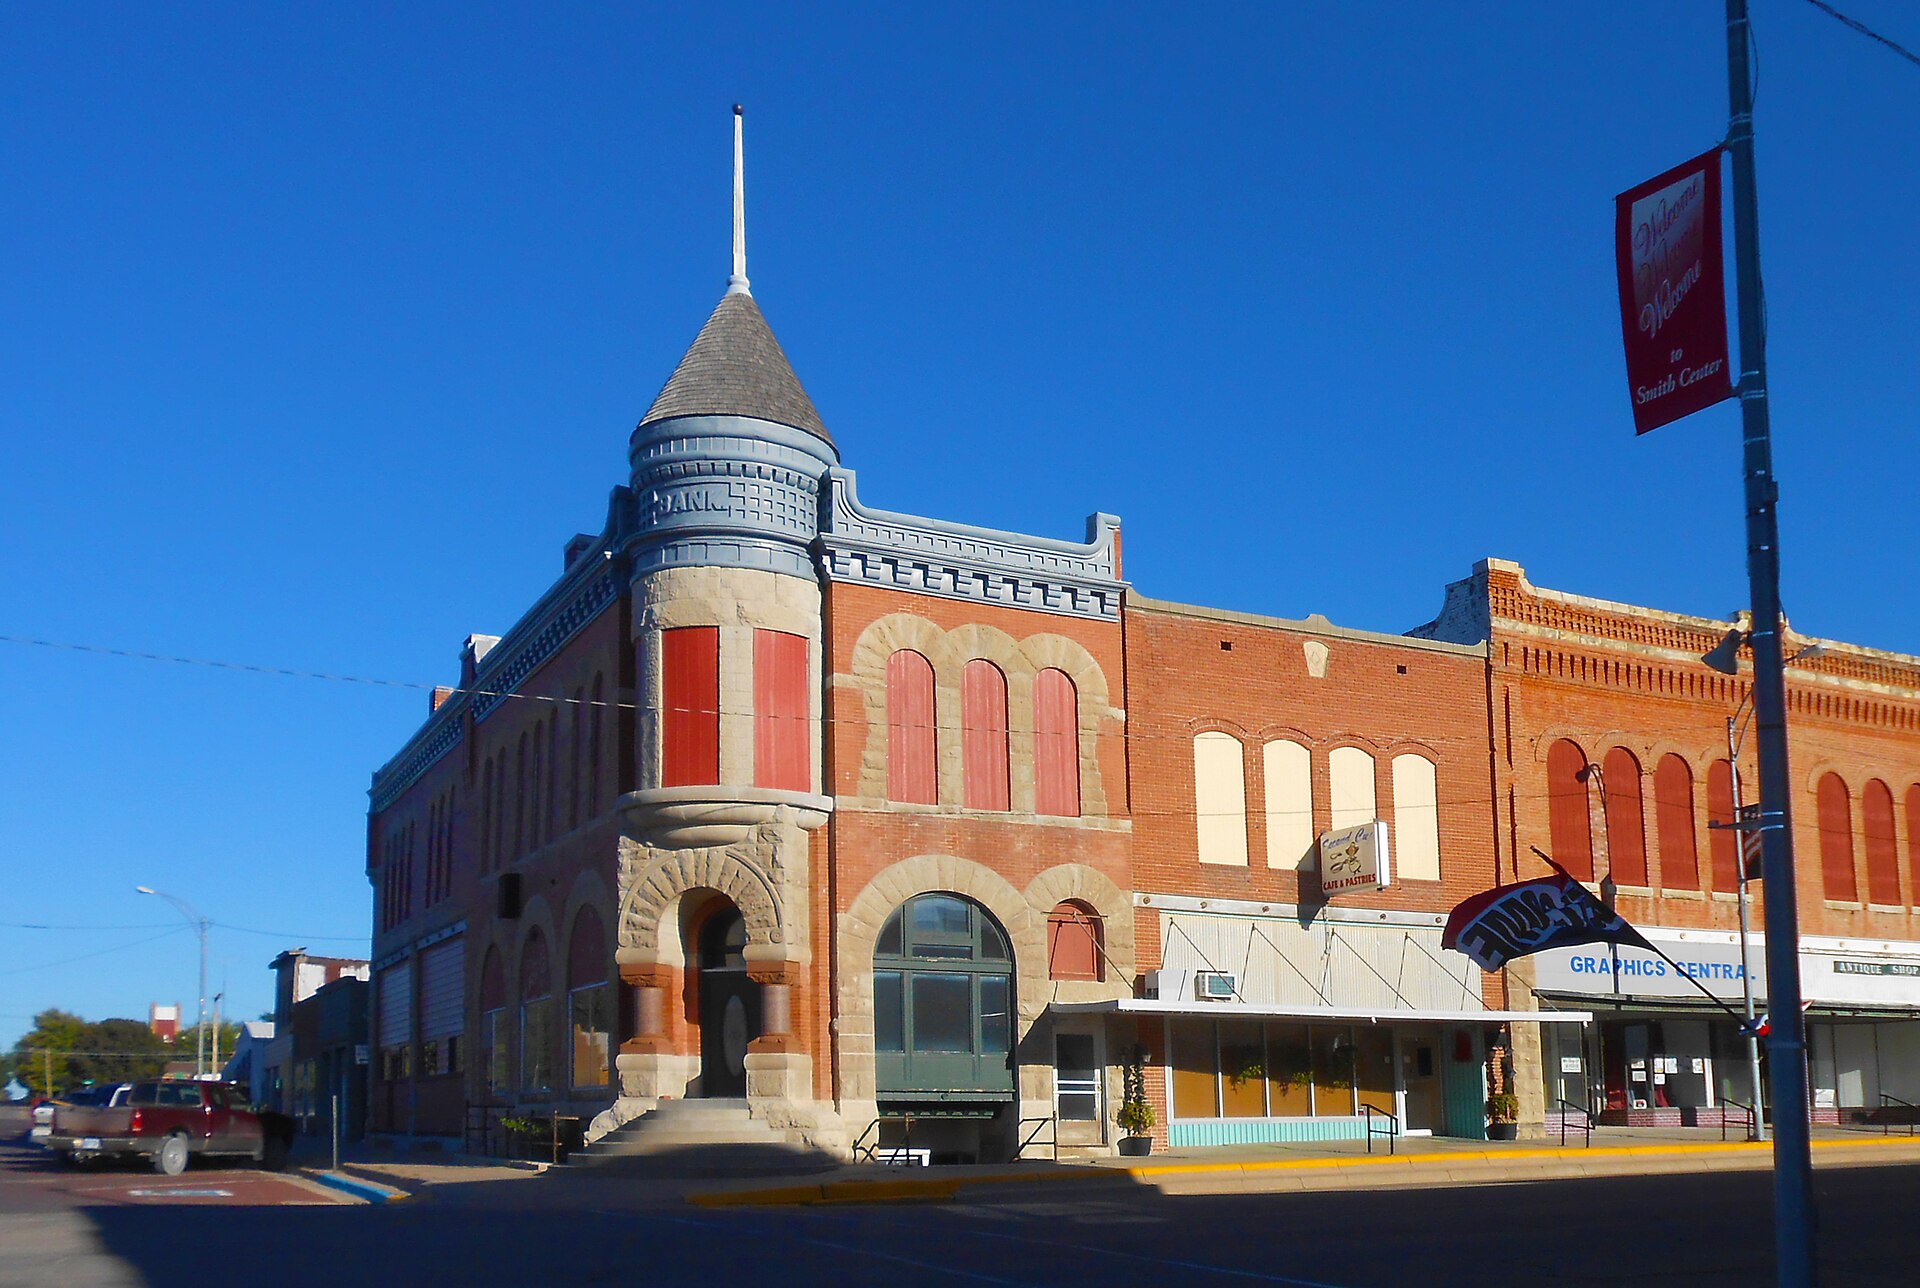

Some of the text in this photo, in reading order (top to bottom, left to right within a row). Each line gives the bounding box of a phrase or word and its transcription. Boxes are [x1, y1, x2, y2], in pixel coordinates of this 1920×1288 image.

[1634, 178, 1698, 256] Welcome
[1639, 259, 1701, 339] Welcome
[1670, 348, 1684, 364] to
[1636, 357, 1723, 406] Smith Center
[658, 490, 728, 514] BANK
[1323, 873, 1377, 891] CAFE & PASTRIES
[1570, 955, 1757, 980] GRAPHICS CENTRA
[1840, 962, 1919, 975] ANTIQUE SHOP
